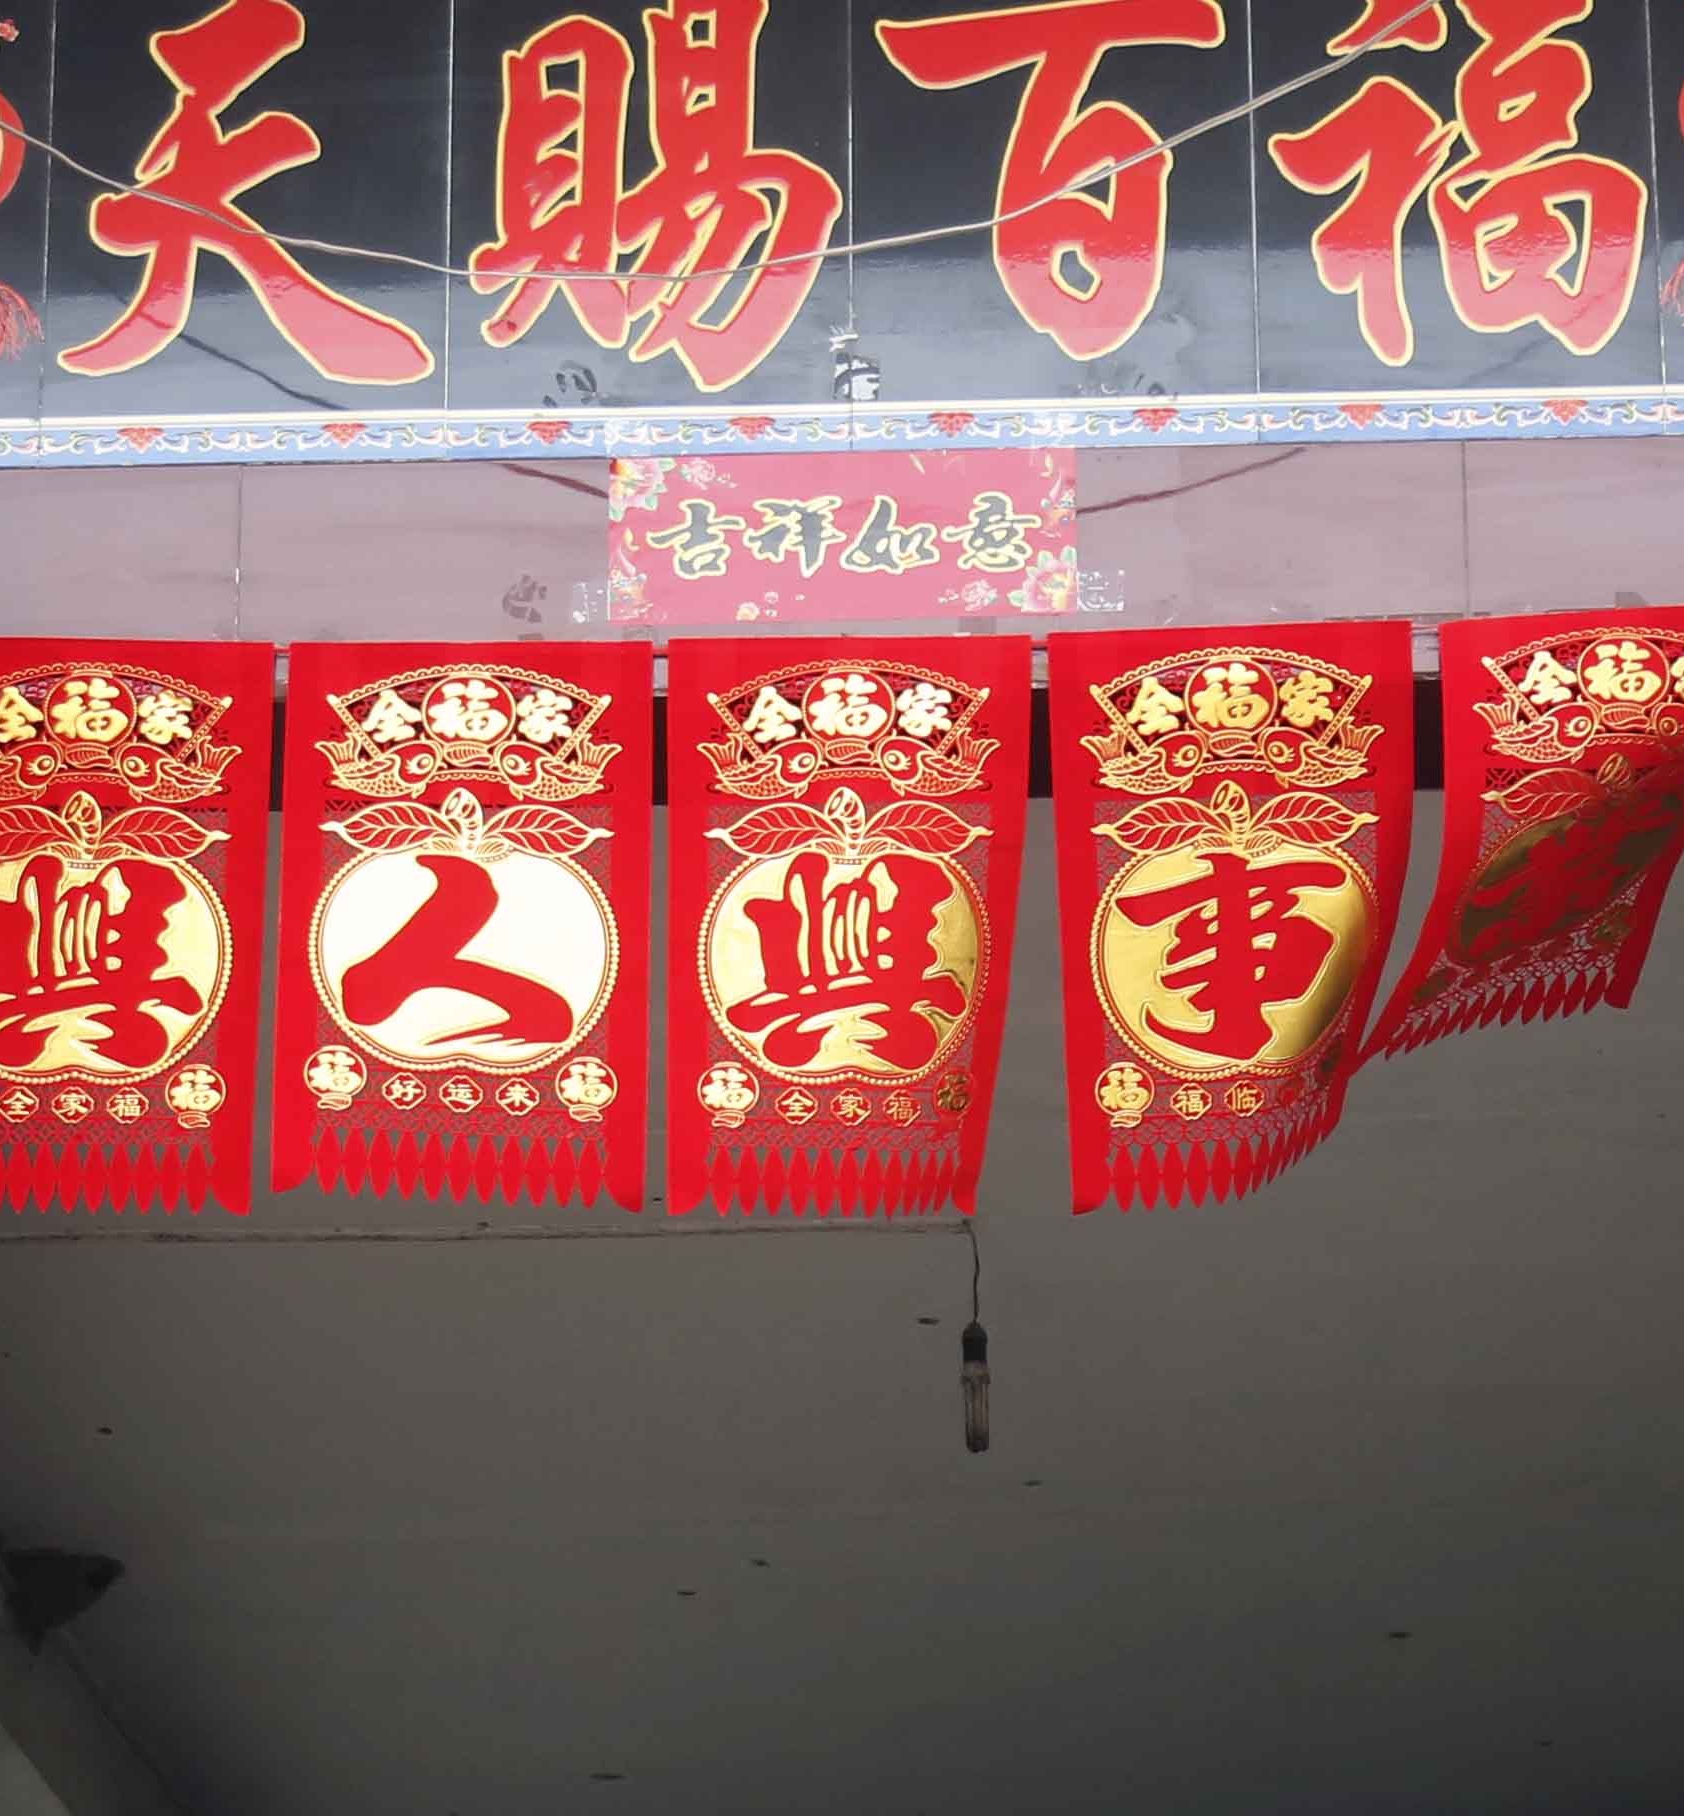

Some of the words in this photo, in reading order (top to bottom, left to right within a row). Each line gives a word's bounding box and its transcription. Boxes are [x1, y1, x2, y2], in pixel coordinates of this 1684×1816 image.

[647, 491, 1042, 580] 吉祥如意
[341, 854, 574, 1045] 人
[1114, 853, 1350, 1062] 事
[168, 1068, 223, 1112] 福
[308, 1050, 363, 1093] 福
[559, 1062, 614, 1107] 福
[702, 1066, 754, 1108] 福
[1100, 1066, 1152, 1112] 福
[1, 1088, 145, 1118] 全家福
[387, 1076, 536, 1113] 好运来
[779, 1089, 919, 1121] 全家福
[1174, 1082, 1263, 1117] 福临
